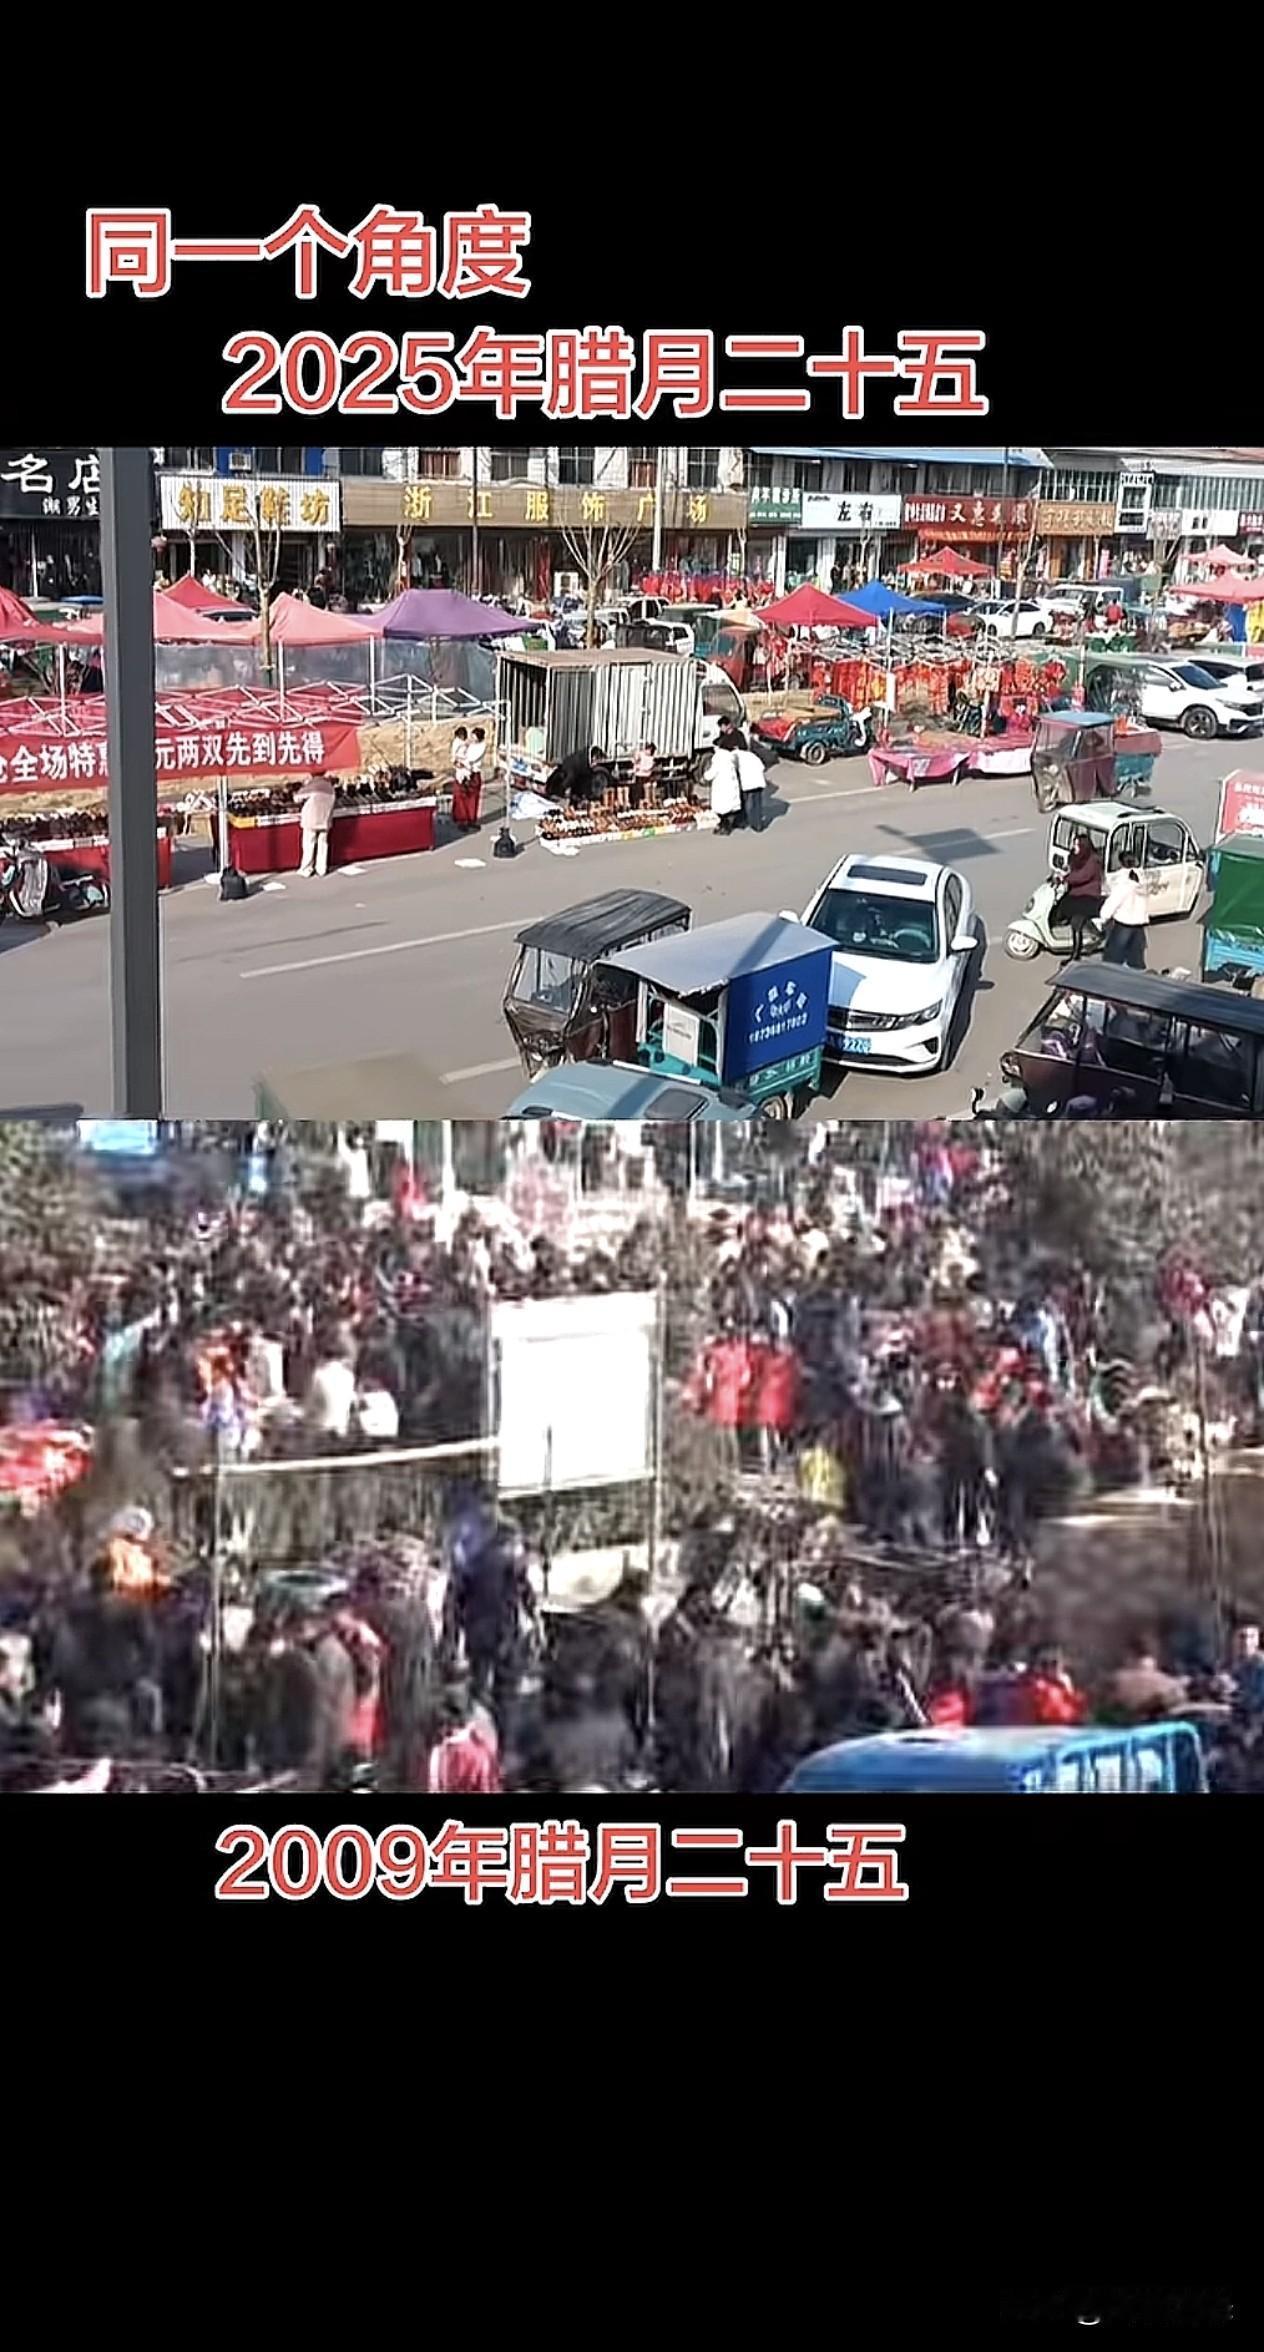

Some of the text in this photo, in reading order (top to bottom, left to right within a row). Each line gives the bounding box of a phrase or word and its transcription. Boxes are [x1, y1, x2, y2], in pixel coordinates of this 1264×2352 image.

[178, 484, 330, 526] 知足鞋坊
[404, 486, 708, 522] 浙江服饰广场
